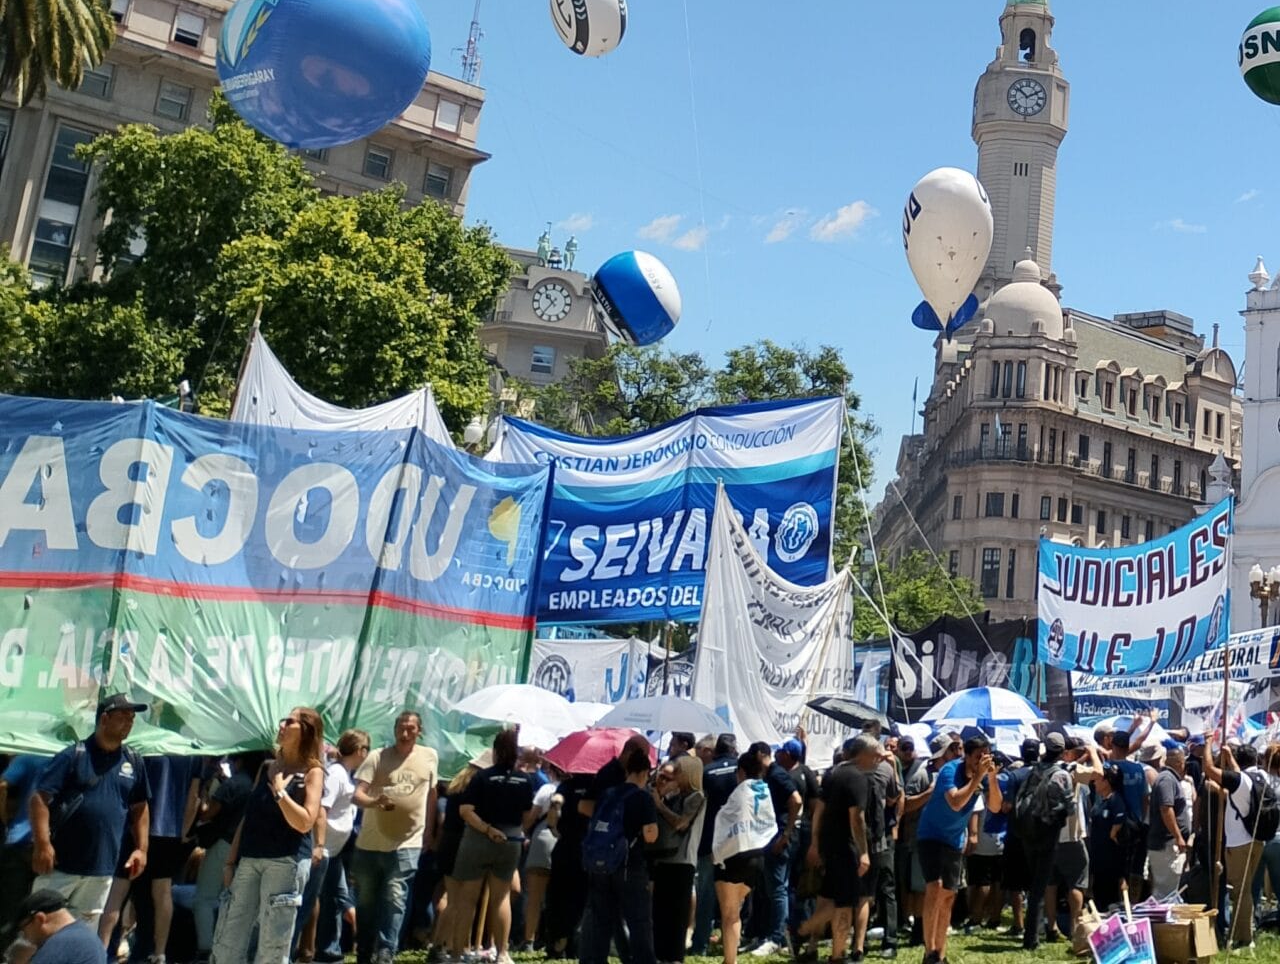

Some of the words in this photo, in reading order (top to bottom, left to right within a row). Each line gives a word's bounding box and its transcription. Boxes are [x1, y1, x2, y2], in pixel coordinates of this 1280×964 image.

[622, 433, 708, 471] JERÓNIMO
[710, 424, 798, 453] CONDUCCIÓN
[560, 507, 770, 583] SEIVAA
[1042, 509, 1230, 608] JUDICIALES
[549, 586, 669, 611] EMPLEADOS
[670, 585, 701, 608] DEL
[1200, 645, 1261, 671] LABORAL
